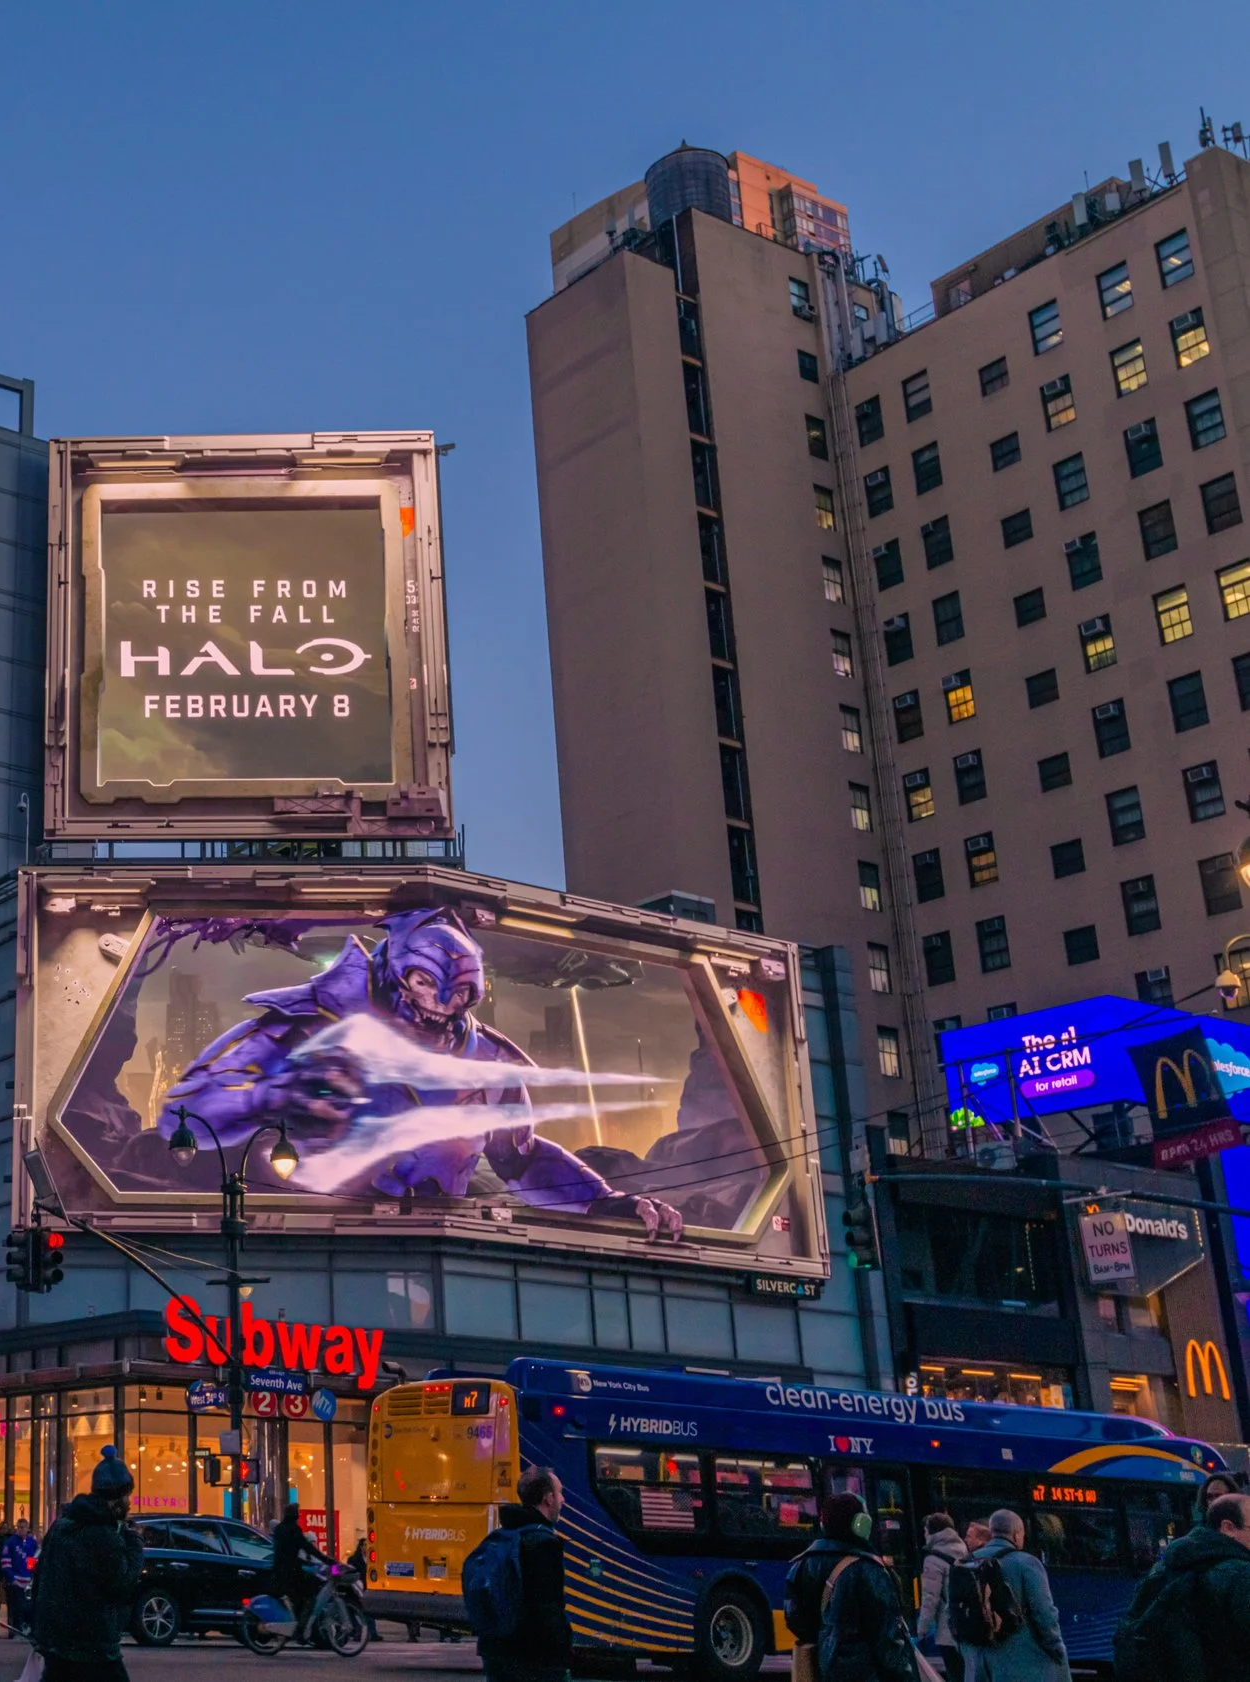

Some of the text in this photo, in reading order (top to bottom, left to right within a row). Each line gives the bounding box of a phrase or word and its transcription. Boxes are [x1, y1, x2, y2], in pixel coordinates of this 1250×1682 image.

[142, 580, 347, 598] RISE FROM
[156, 605, 335, 623] THE FALL
[120, 637, 372, 677] HALO
[144, 694, 350, 718] FEBRUARY 8
[1021, 1025, 1077, 1053] The #1
[1018, 1046, 1092, 1078] AI CRM
[1035, 1074, 1078, 1092] for retail
[1190, 1138, 1208, 1152] 24
[1208, 1128, 1235, 1147] HRS
[1092, 1220, 1115, 1238] NO
[1088, 1241, 1129, 1259] TURNS
[164, 1294, 384, 1391] Subway
[250, 1374, 303, 1392] Seventh Ave
[592, 1379, 608, 1388] New
[608, 1380, 623, 1389] York
[623, 1382, 637, 1392] City
[637, 1382, 650, 1392] Bus
[190, 1394, 206, 1406] West
[218, 1391, 225, 1404] St
[257, 1391, 332, 1418] 2 3 MTA
[463, 1391, 479, 1408] M7
[765, 1384, 917, 1425] clean-energy
[921, 1396, 965, 1422] bus
[620, 1416, 699, 1437] HYBRIDBUS
[848, 1436, 874, 1455] NY
[1051, 1487, 1063, 1501] 14
[411, 1526, 467, 1542] HYBRIDBUS
